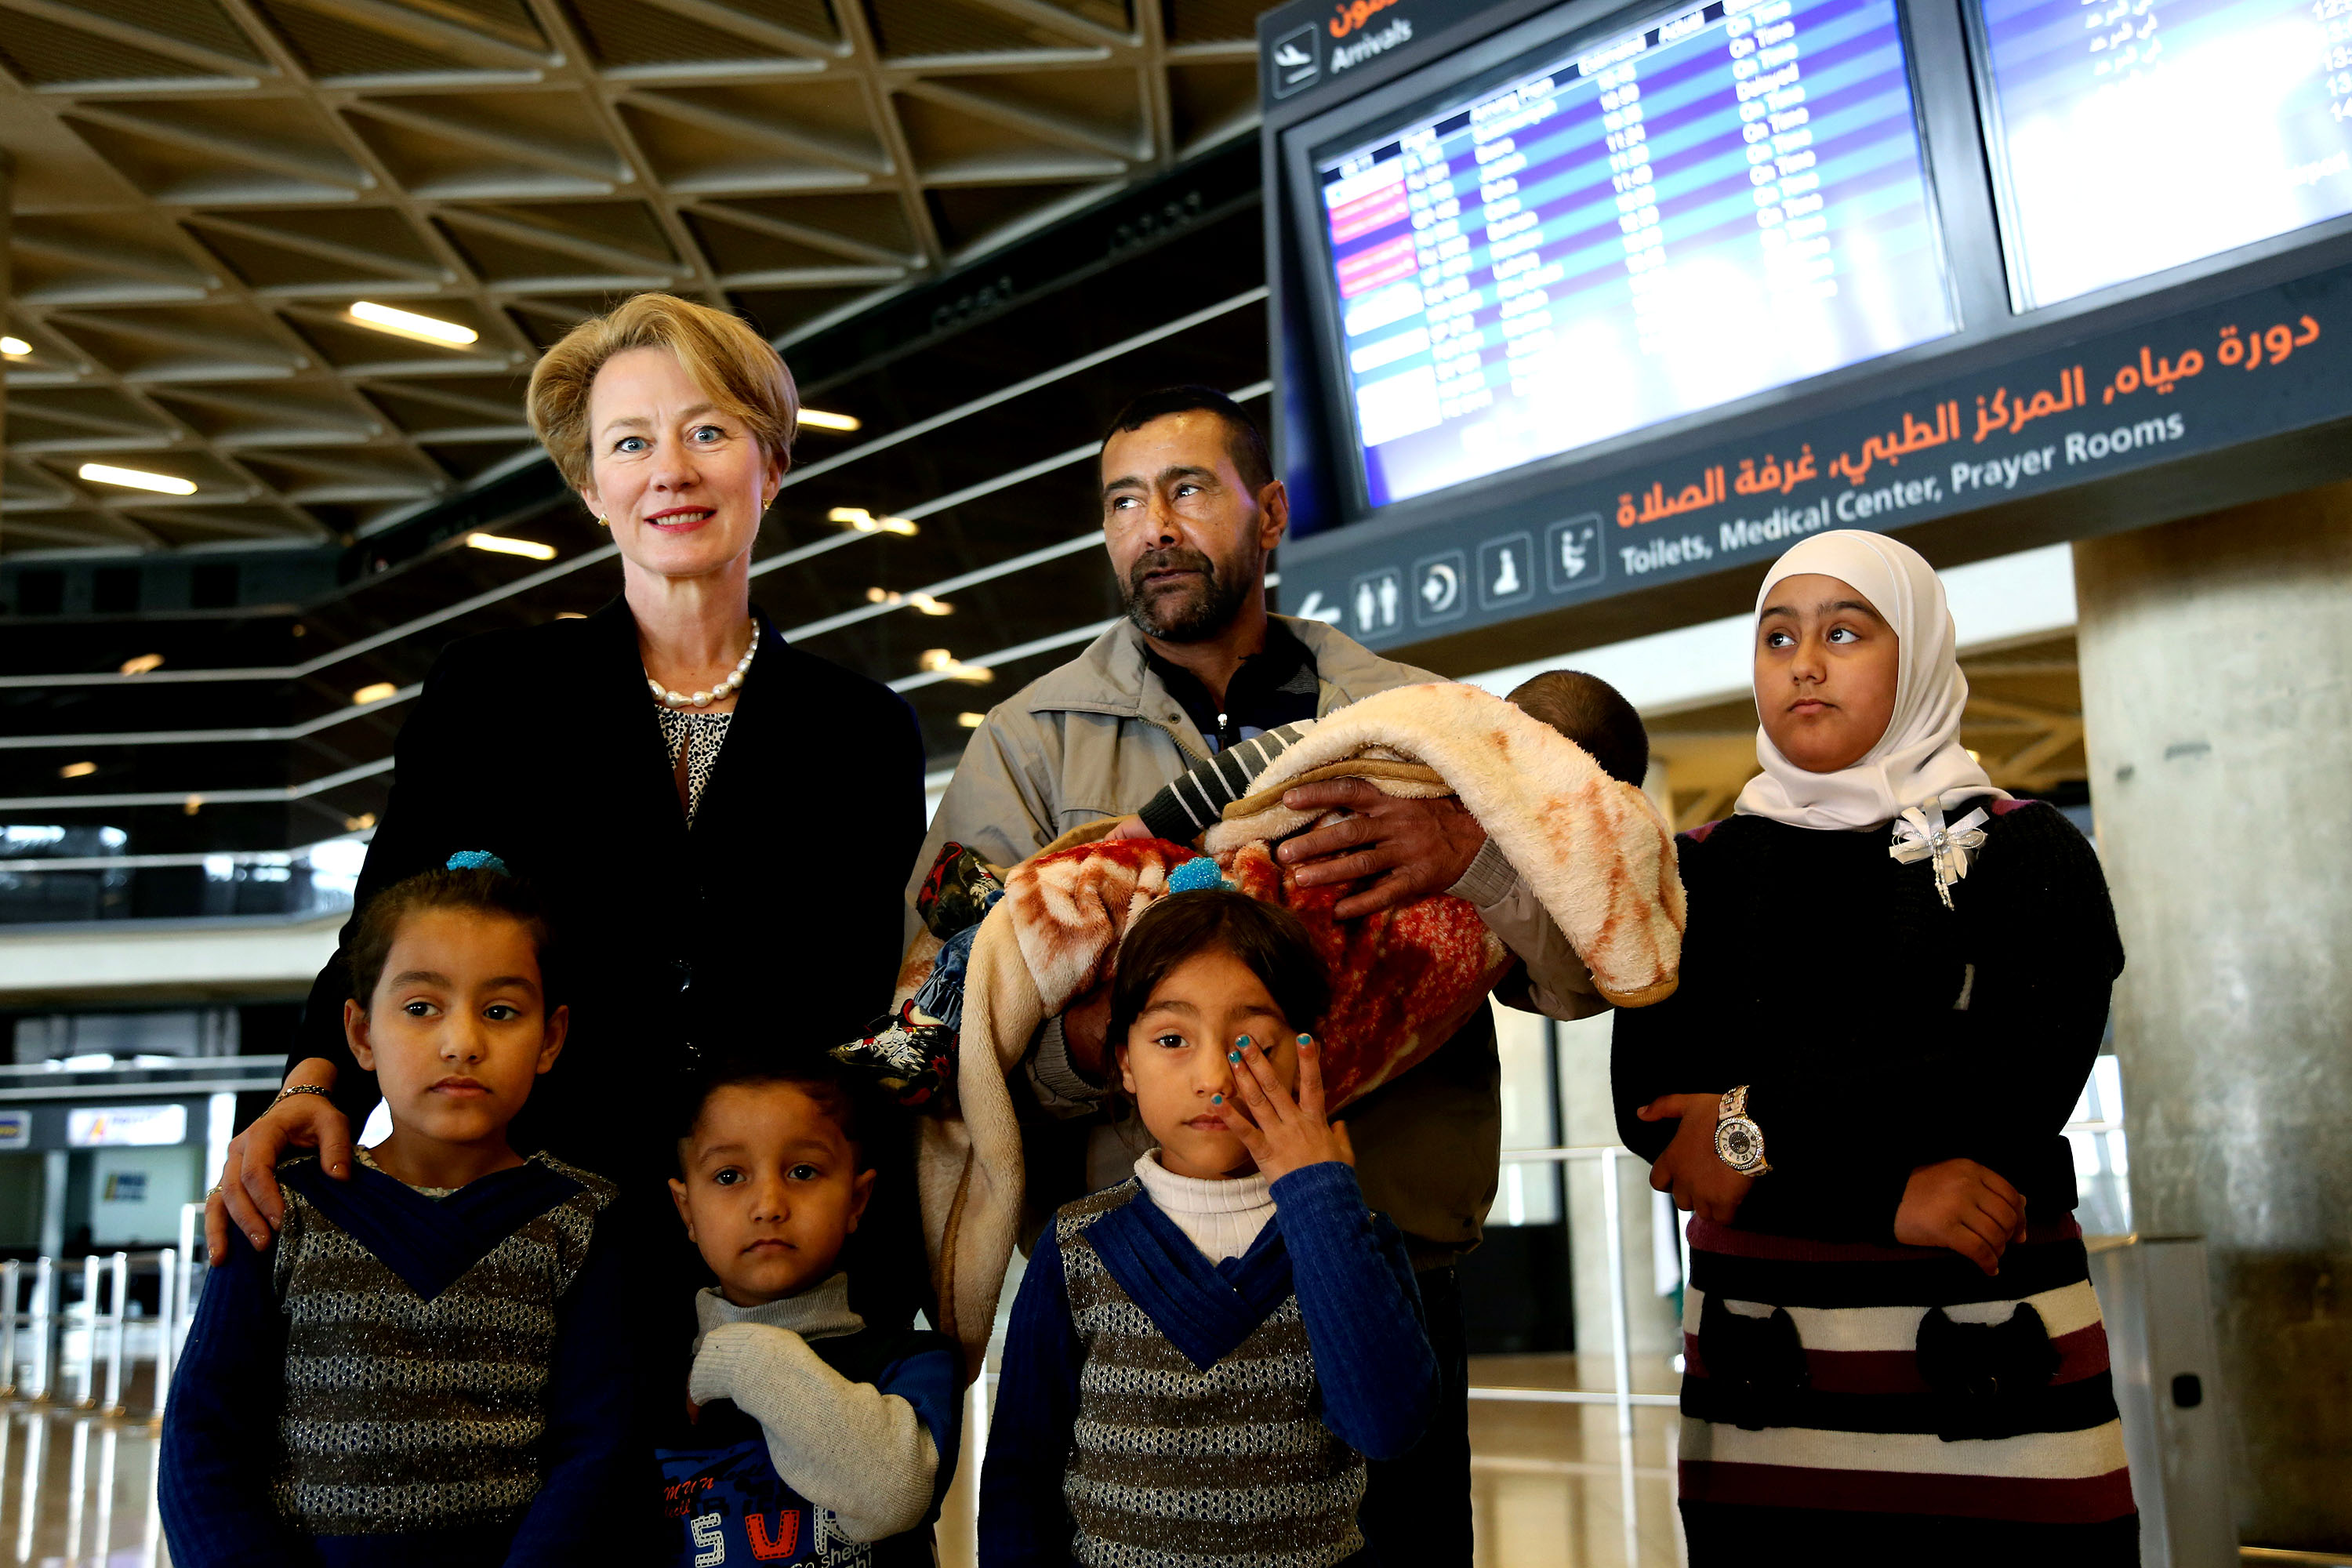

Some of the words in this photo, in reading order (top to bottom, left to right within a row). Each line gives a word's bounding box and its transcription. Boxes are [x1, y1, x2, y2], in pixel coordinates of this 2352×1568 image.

[1330, 17, 1412, 74] Arrivals
[2216, 314, 2321, 372] دورة
[1972, 363, 2087, 445] المركز
[1615, 464, 1726, 529] الصلاة
[1619, 534, 1714, 576] Toilets,
[1719, 496, 1831, 553] Medical
[1835, 475, 1943, 523] Center,
[1950, 444, 2056, 495] Prayer
[2064, 412, 2185, 466] Rooms
[1733, 442, 1818, 495] غرفة
